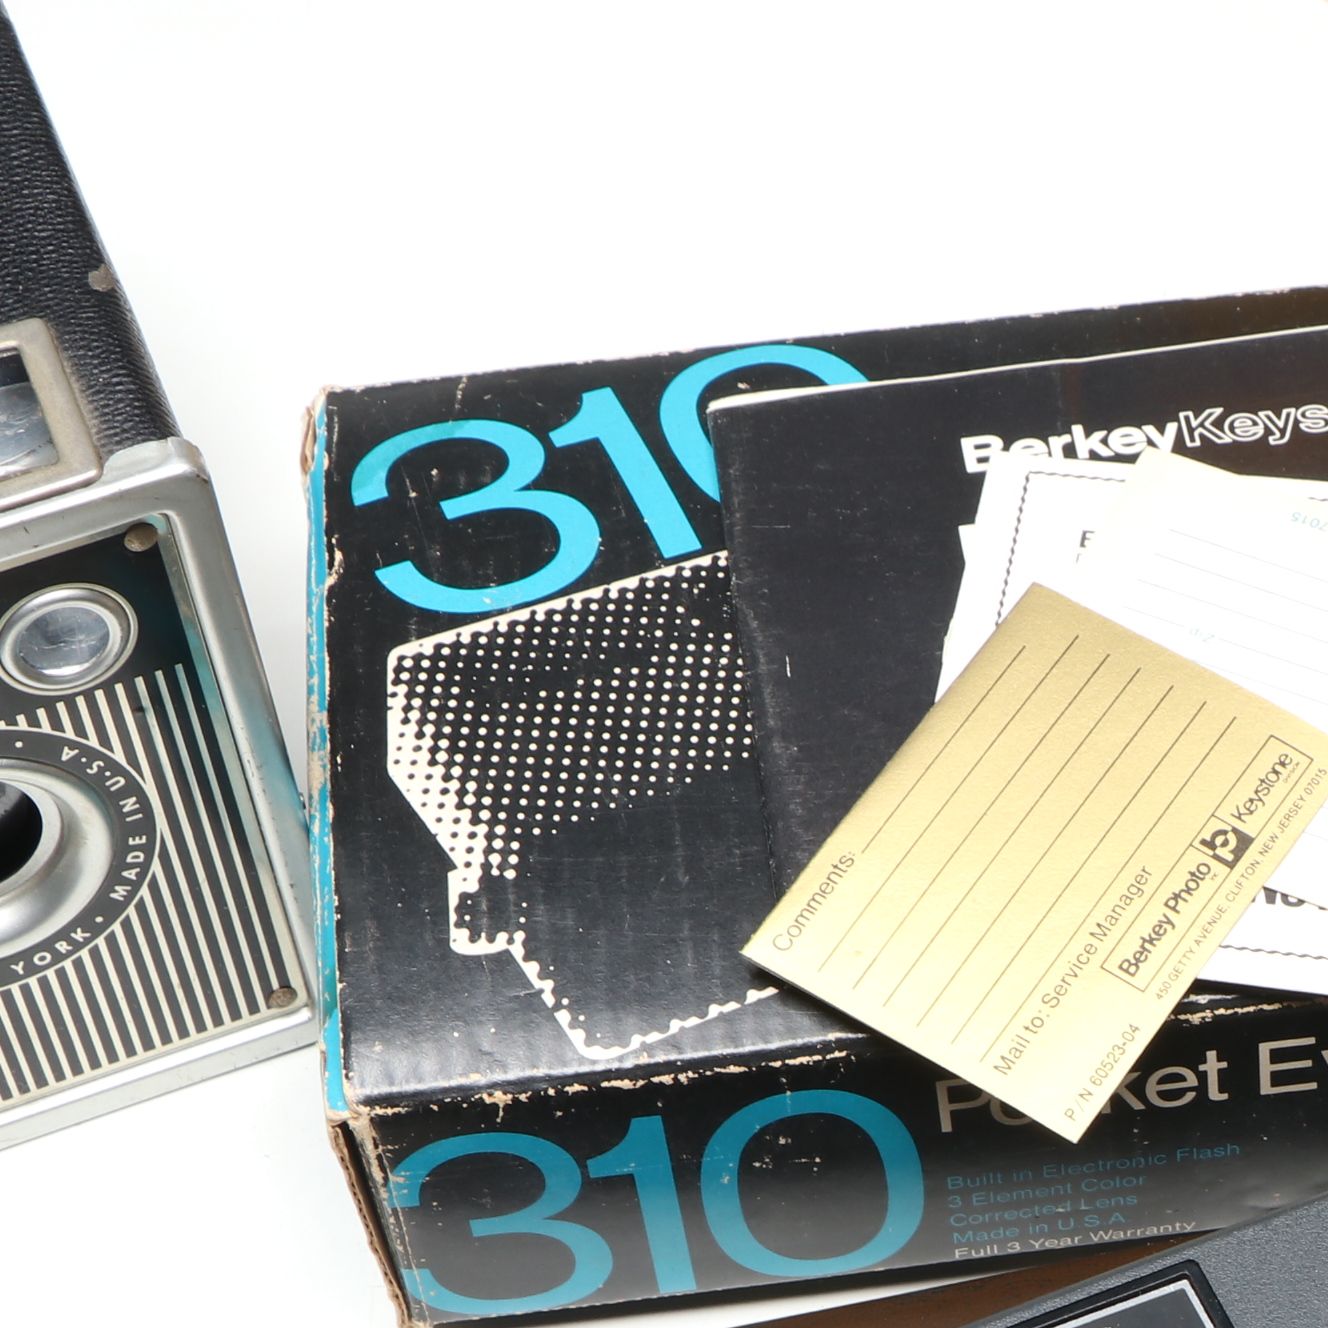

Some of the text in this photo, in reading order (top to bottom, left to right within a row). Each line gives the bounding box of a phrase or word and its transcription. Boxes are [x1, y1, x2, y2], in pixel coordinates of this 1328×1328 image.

[119, 796, 144, 822] IN
[1230, 752, 1294, 824] Keystone
[109, 834, 148, 902] MADE
[1156, 981, 1173, 1001] 450
[1168, 946, 1197, 983] GETTY
[1258, 833, 1280, 858] NEW
[1277, 796, 1307, 835] JERSEY
[1303, 767, 1328, 797] 07015
[772, 851, 856, 952] Comments:
[1118, 861, 1213, 979] Berkey Photo
[10, 927, 92, 977] YORK
[992, 865, 1153, 1076] Mail to: Service Manager
[1089, 1022, 1141, 1087] 60523-04
[946, 1142, 1240, 1190] Built in Electronic Flash
[947, 1173, 1148, 1208] 3 Element Color
[389, 1088, 926, 1316] 310
[949, 1193, 1138, 1227] Corrected Lens
[952, 1226, 1019, 1245] Made
[1028, 1219, 1048, 1235] in
[954, 1220, 1198, 1260] Full 3 Year Warranty
